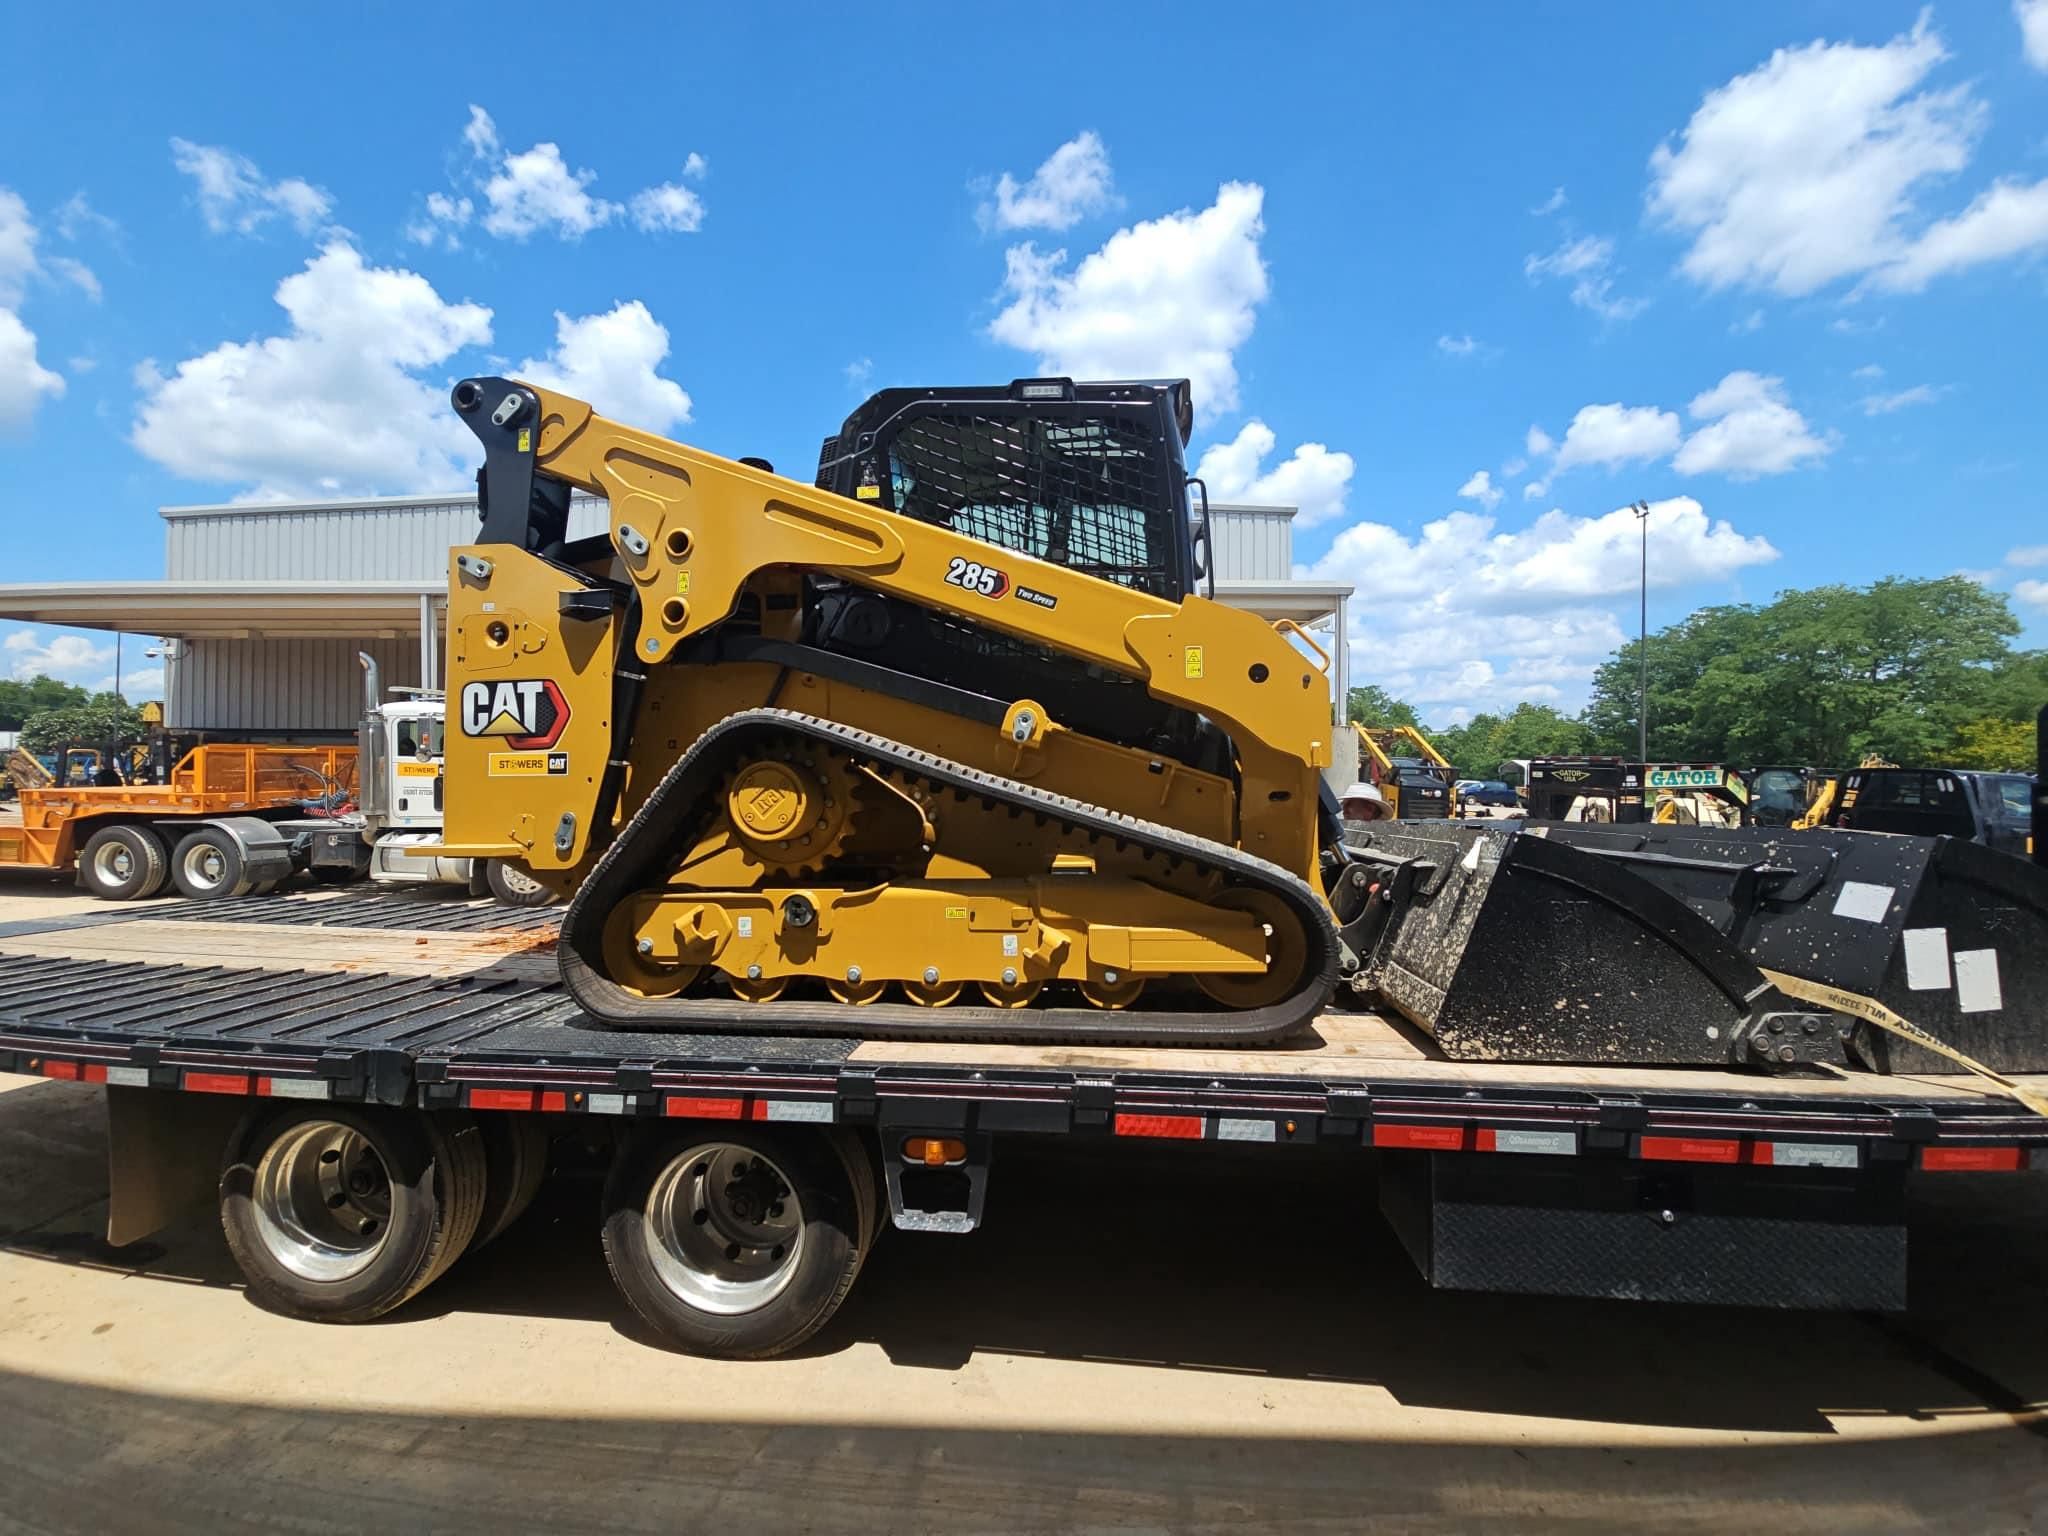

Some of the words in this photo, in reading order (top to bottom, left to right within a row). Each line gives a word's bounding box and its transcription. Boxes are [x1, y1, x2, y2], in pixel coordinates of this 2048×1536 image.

[944, 557, 998, 594] 285
[463, 680, 543, 735] CAT
[549, 758, 566, 769] CAT
[1559, 769, 1582, 777] GATOR
[1651, 771, 1718, 786] GATOR
